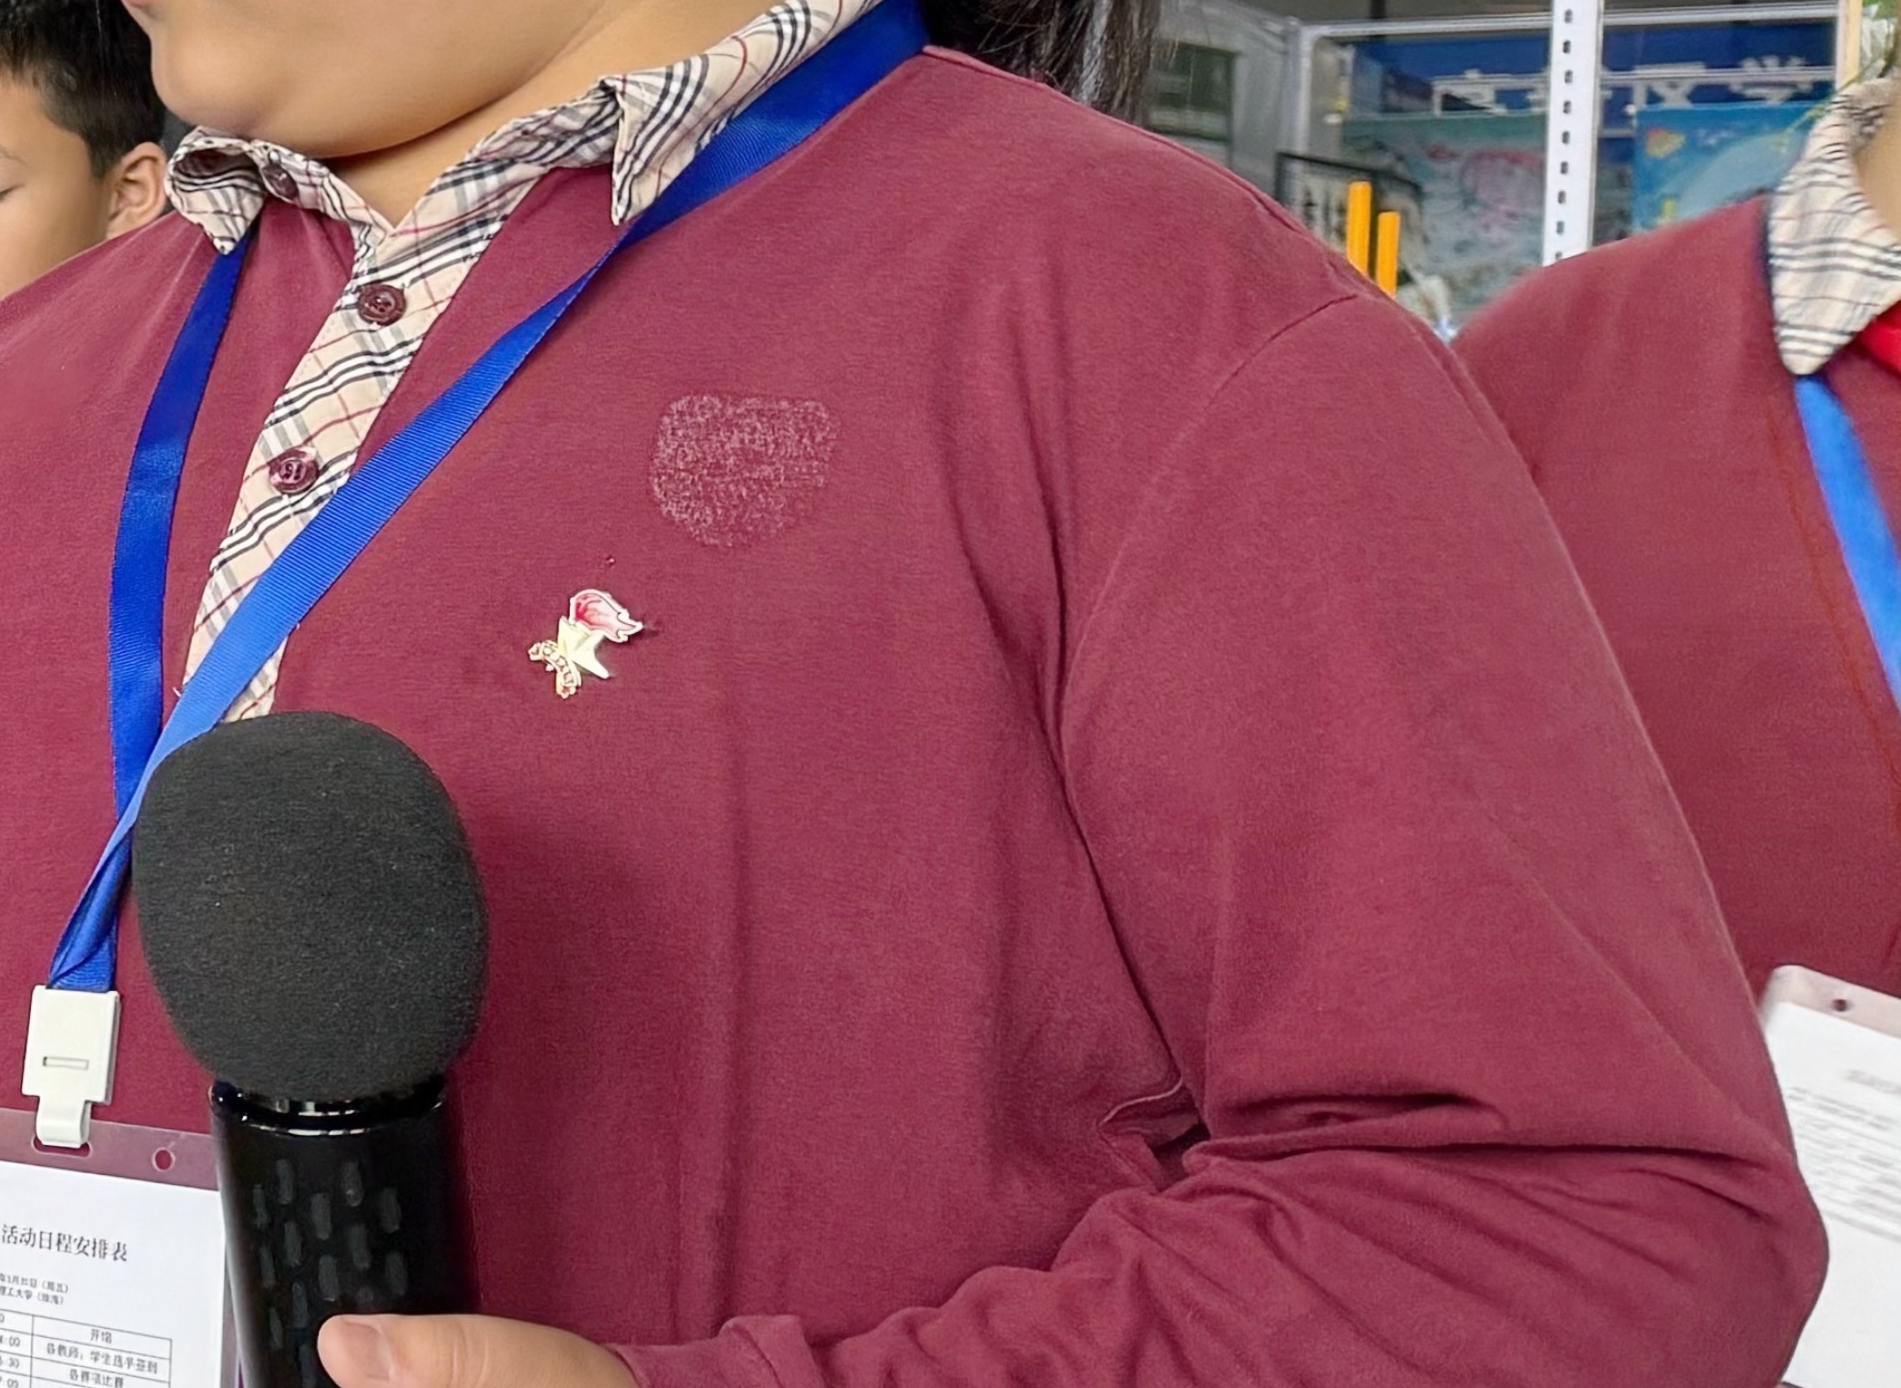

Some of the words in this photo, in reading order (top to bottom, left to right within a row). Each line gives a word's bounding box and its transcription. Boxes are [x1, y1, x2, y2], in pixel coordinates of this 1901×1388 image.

[1, 1221, 129, 1264] 活动日程安排表
